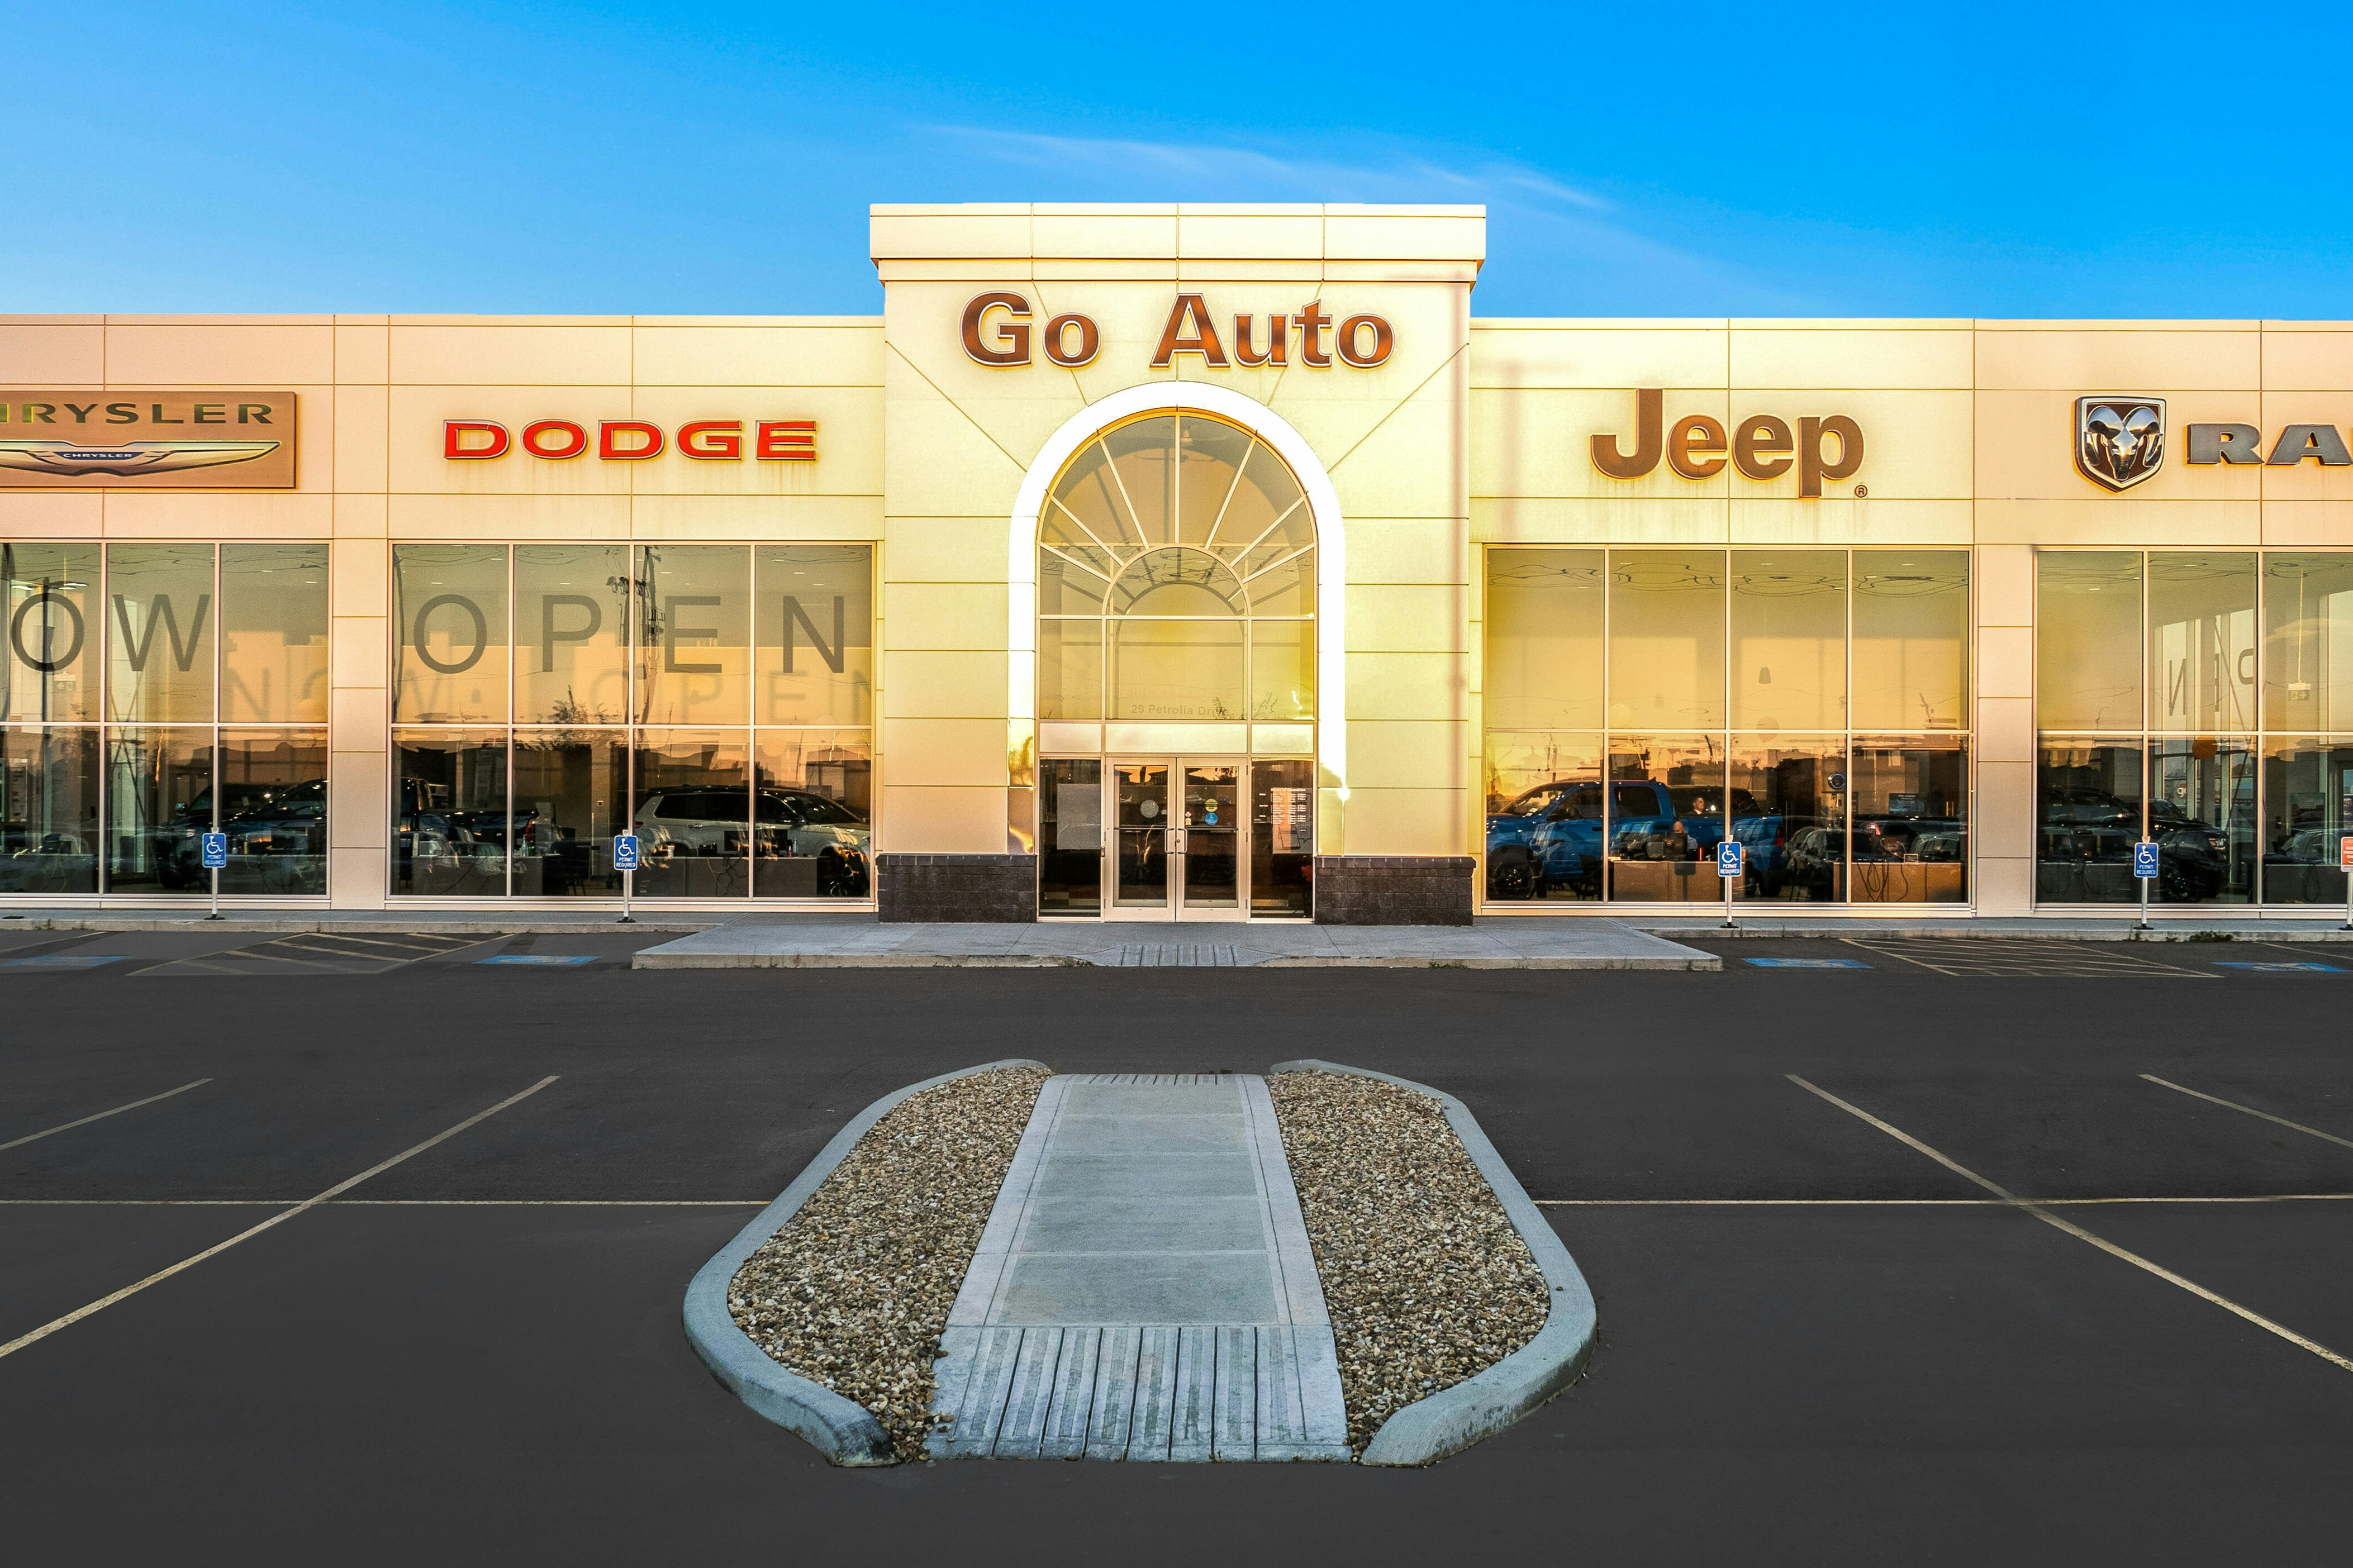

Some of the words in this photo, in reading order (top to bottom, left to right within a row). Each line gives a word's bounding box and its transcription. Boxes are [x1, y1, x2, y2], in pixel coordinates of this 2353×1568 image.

[959, 290, 1101, 368] Go
[1149, 293, 1396, 368] Auto
[443, 419, 816, 461] DODGE
[1591, 388, 1865, 499] Jeep
[413, 593, 845, 675] OPEN
[1130, 704, 1144, 714] 29
[1148, 704, 1194, 715] Petrolia
[1198, 706, 1228, 716] Dri
